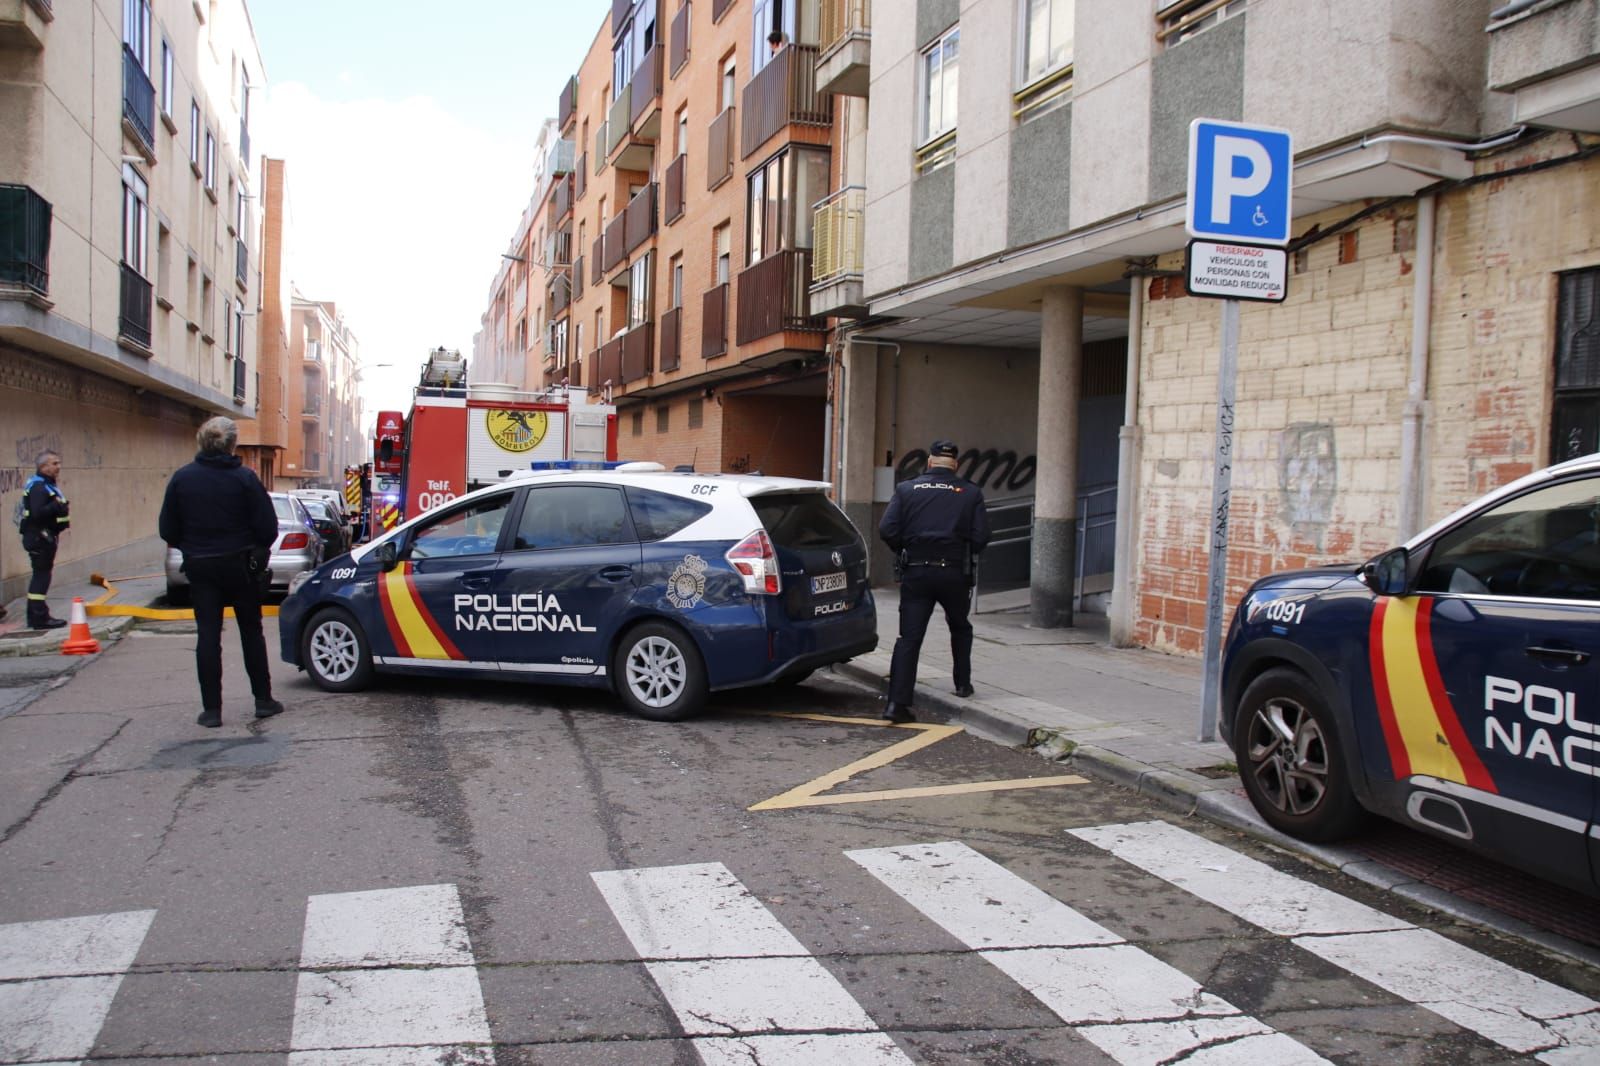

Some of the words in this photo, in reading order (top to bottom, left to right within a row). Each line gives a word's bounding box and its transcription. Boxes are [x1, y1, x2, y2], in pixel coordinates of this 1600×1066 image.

[1211, 134, 1272, 225] P
[1215, 245, 1264, 257] RESERVADO
[1209, 255, 1256, 268] VEHÍCULOS
[1257, 260, 1270, 269] DE
[1207, 266, 1251, 278] PERSONAS
[1252, 270, 1271, 280] CON
[1194, 276, 1240, 288] MOVILIDAD
[1240, 280, 1281, 291] REDUCIDA
[494, 434, 539, 450] BOMBEROS
[426, 480, 451, 491] Telf.
[690, 484, 719, 496] 8CF
[454, 590, 562, 613] POLICÍA
[455, 614, 597, 632] NACIONAL
